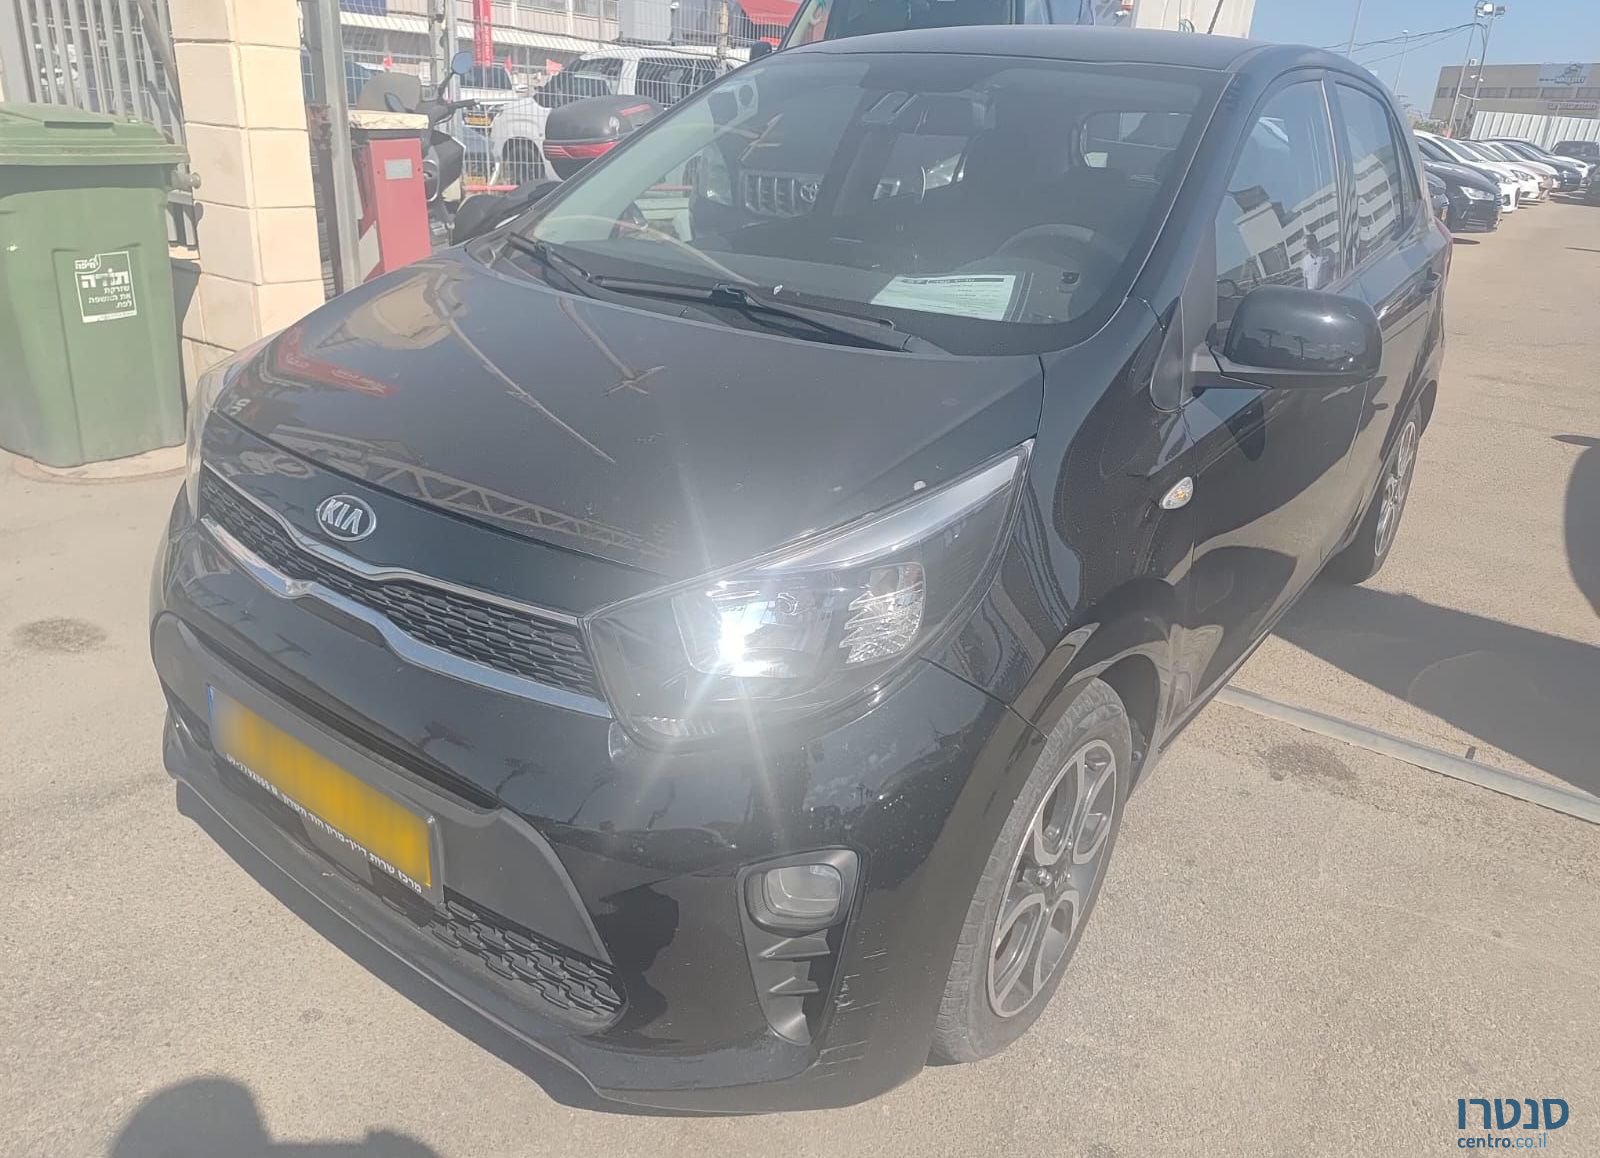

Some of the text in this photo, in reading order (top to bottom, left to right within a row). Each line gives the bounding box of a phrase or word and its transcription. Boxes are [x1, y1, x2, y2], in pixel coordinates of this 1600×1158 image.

[81, 268, 130, 288] תודה
[120, 293, 132, 301] את
[321, 498, 363, 535] KIA
[398, 869, 422, 894] מרכז
